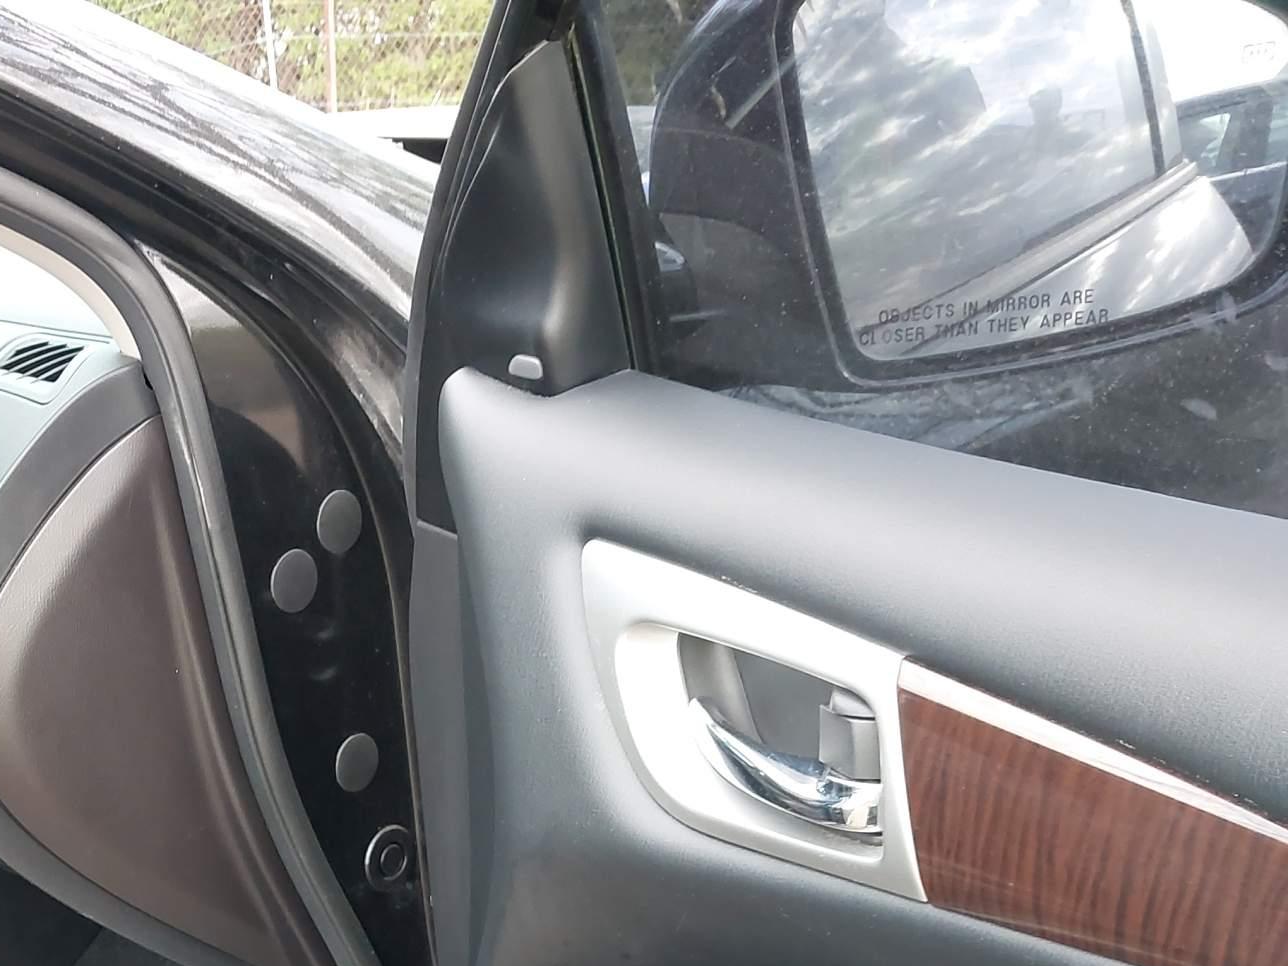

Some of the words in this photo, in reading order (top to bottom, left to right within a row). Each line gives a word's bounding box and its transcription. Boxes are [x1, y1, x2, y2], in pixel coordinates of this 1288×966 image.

[878, 303, 955, 325] OBJECTS
[962, 302, 980, 317] IN
[985, 293, 1051, 314] MIRROR
[1059, 288, 1095, 306] ARE
[858, 326, 926, 347] CLOSER
[934, 319, 979, 341] THAN
[989, 314, 1031, 334] THEY
[1039, 308, 1111, 329] APPEAR
